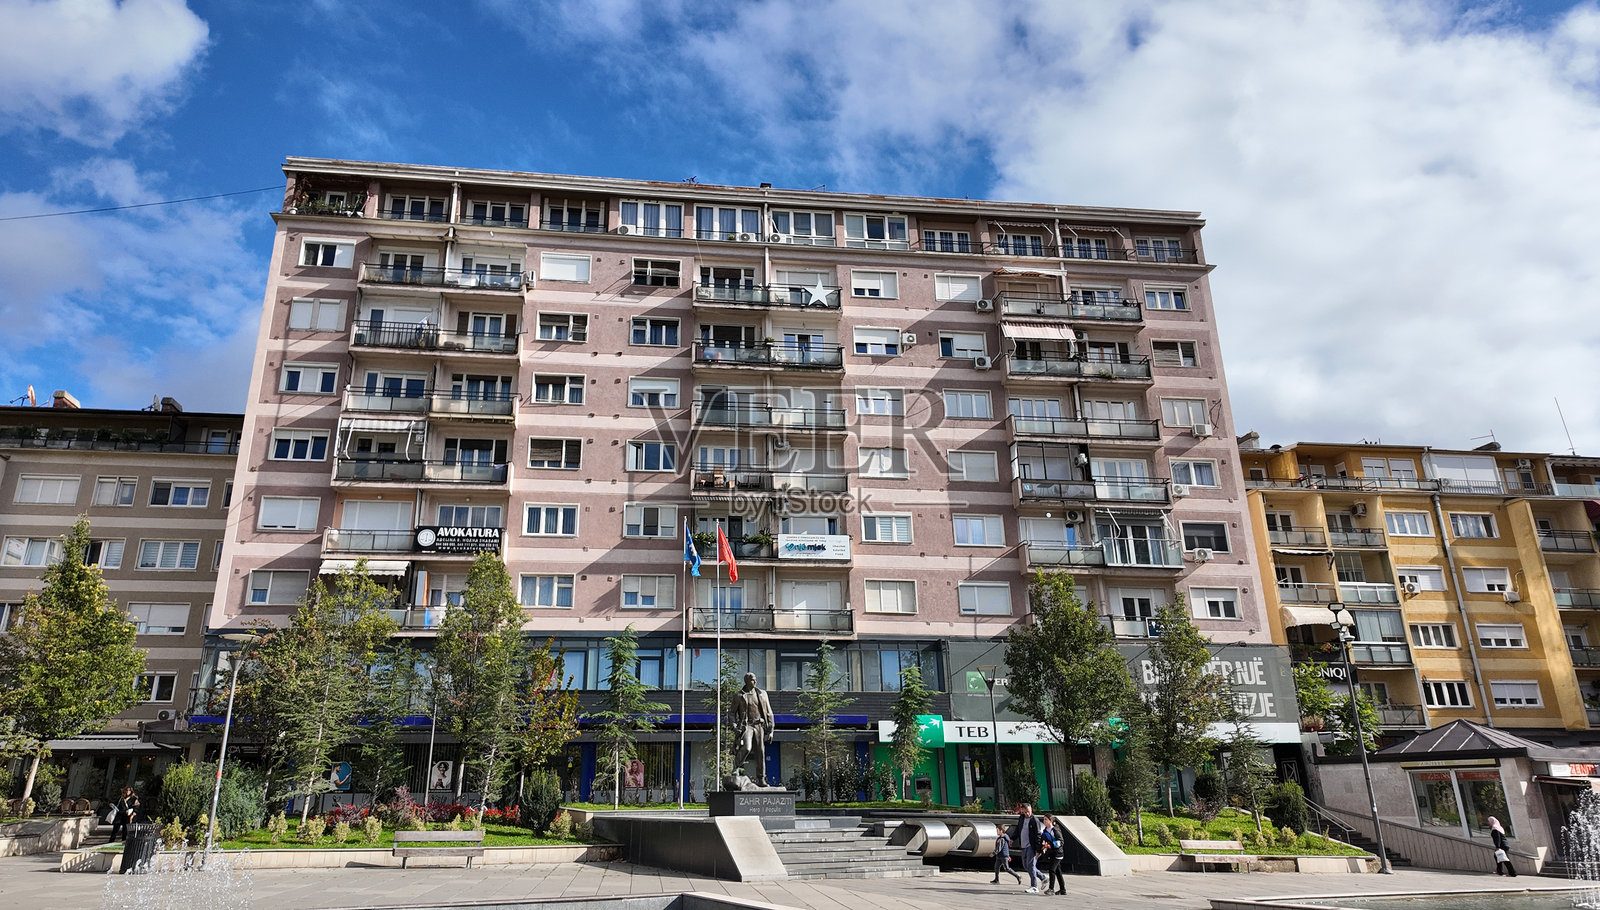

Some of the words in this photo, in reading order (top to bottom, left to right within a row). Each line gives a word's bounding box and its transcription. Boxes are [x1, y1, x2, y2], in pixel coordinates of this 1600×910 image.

[437, 527, 499, 538] AVOKATURA
[1235, 657, 1267, 686] NJË
[955, 726, 989, 738] TEB
